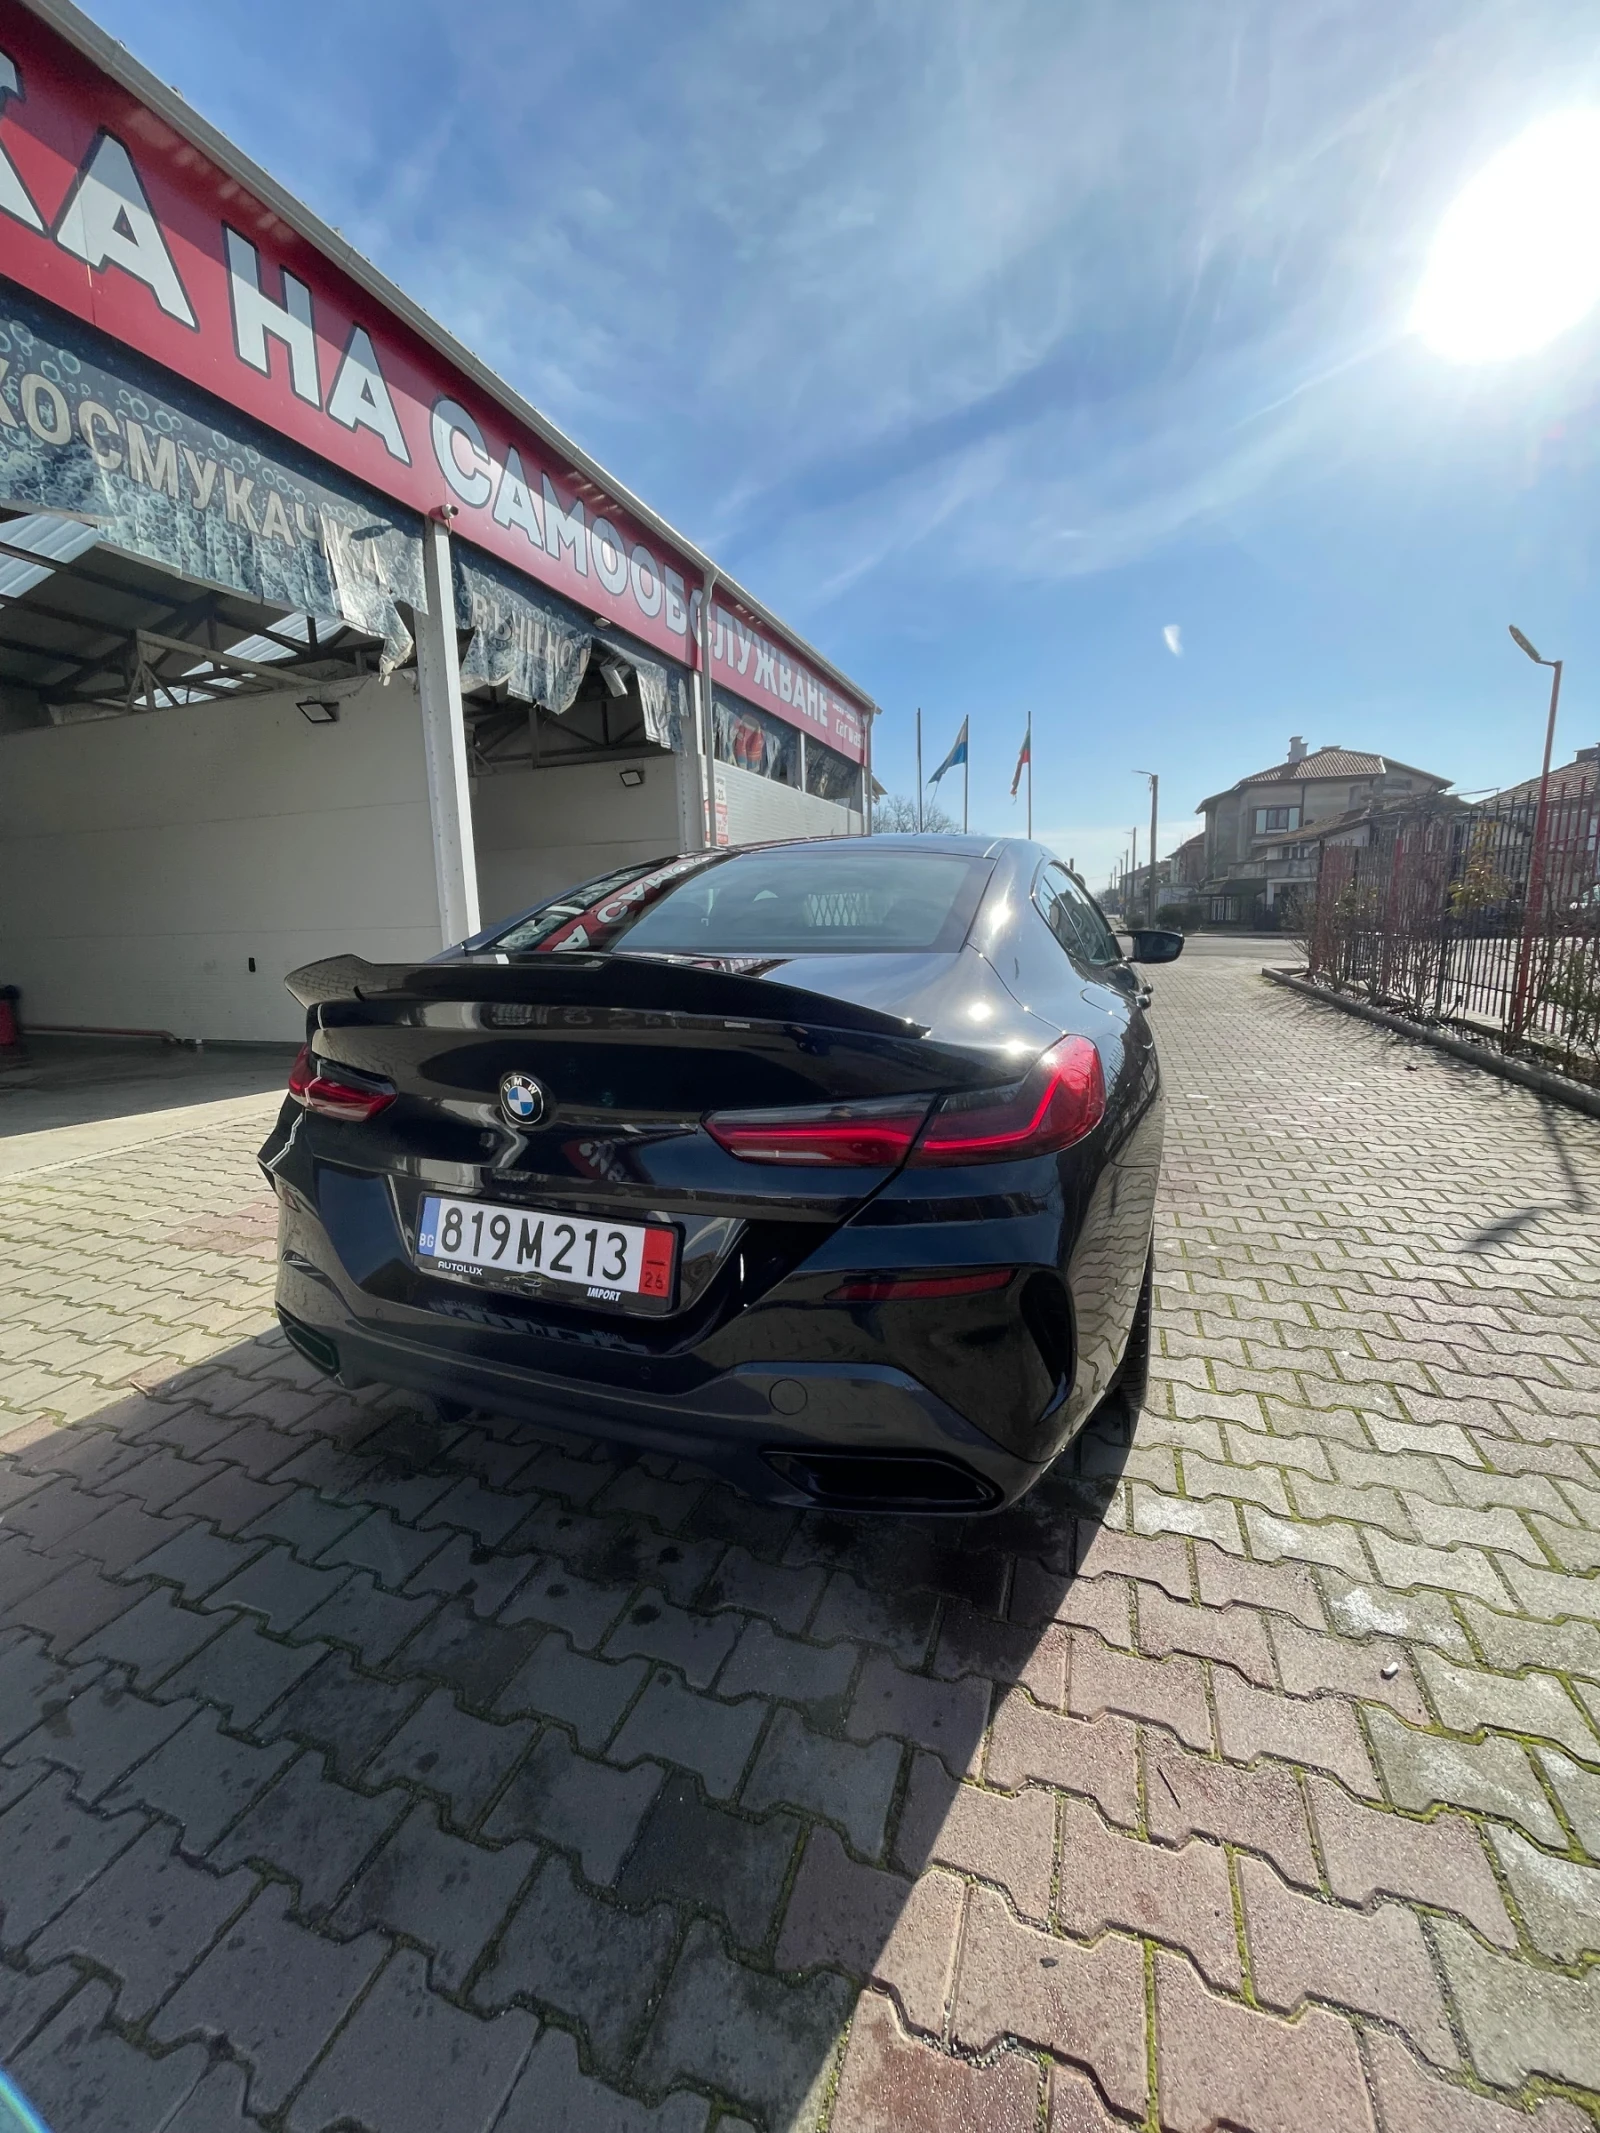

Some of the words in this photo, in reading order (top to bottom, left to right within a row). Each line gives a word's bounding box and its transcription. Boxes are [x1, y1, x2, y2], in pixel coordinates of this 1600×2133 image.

[221, 221, 412, 466] НА
[431, 394, 828, 728] САМООБСЛУЖВАНЕ
[503, 1077, 538, 1095] BMW
[419, 1232, 435, 1248] BG
[441, 1207, 628, 1281] 819M213
[438, 1260, 483, 1276] AUTOLUX
[586, 1286, 622, 1303] IMPORT
